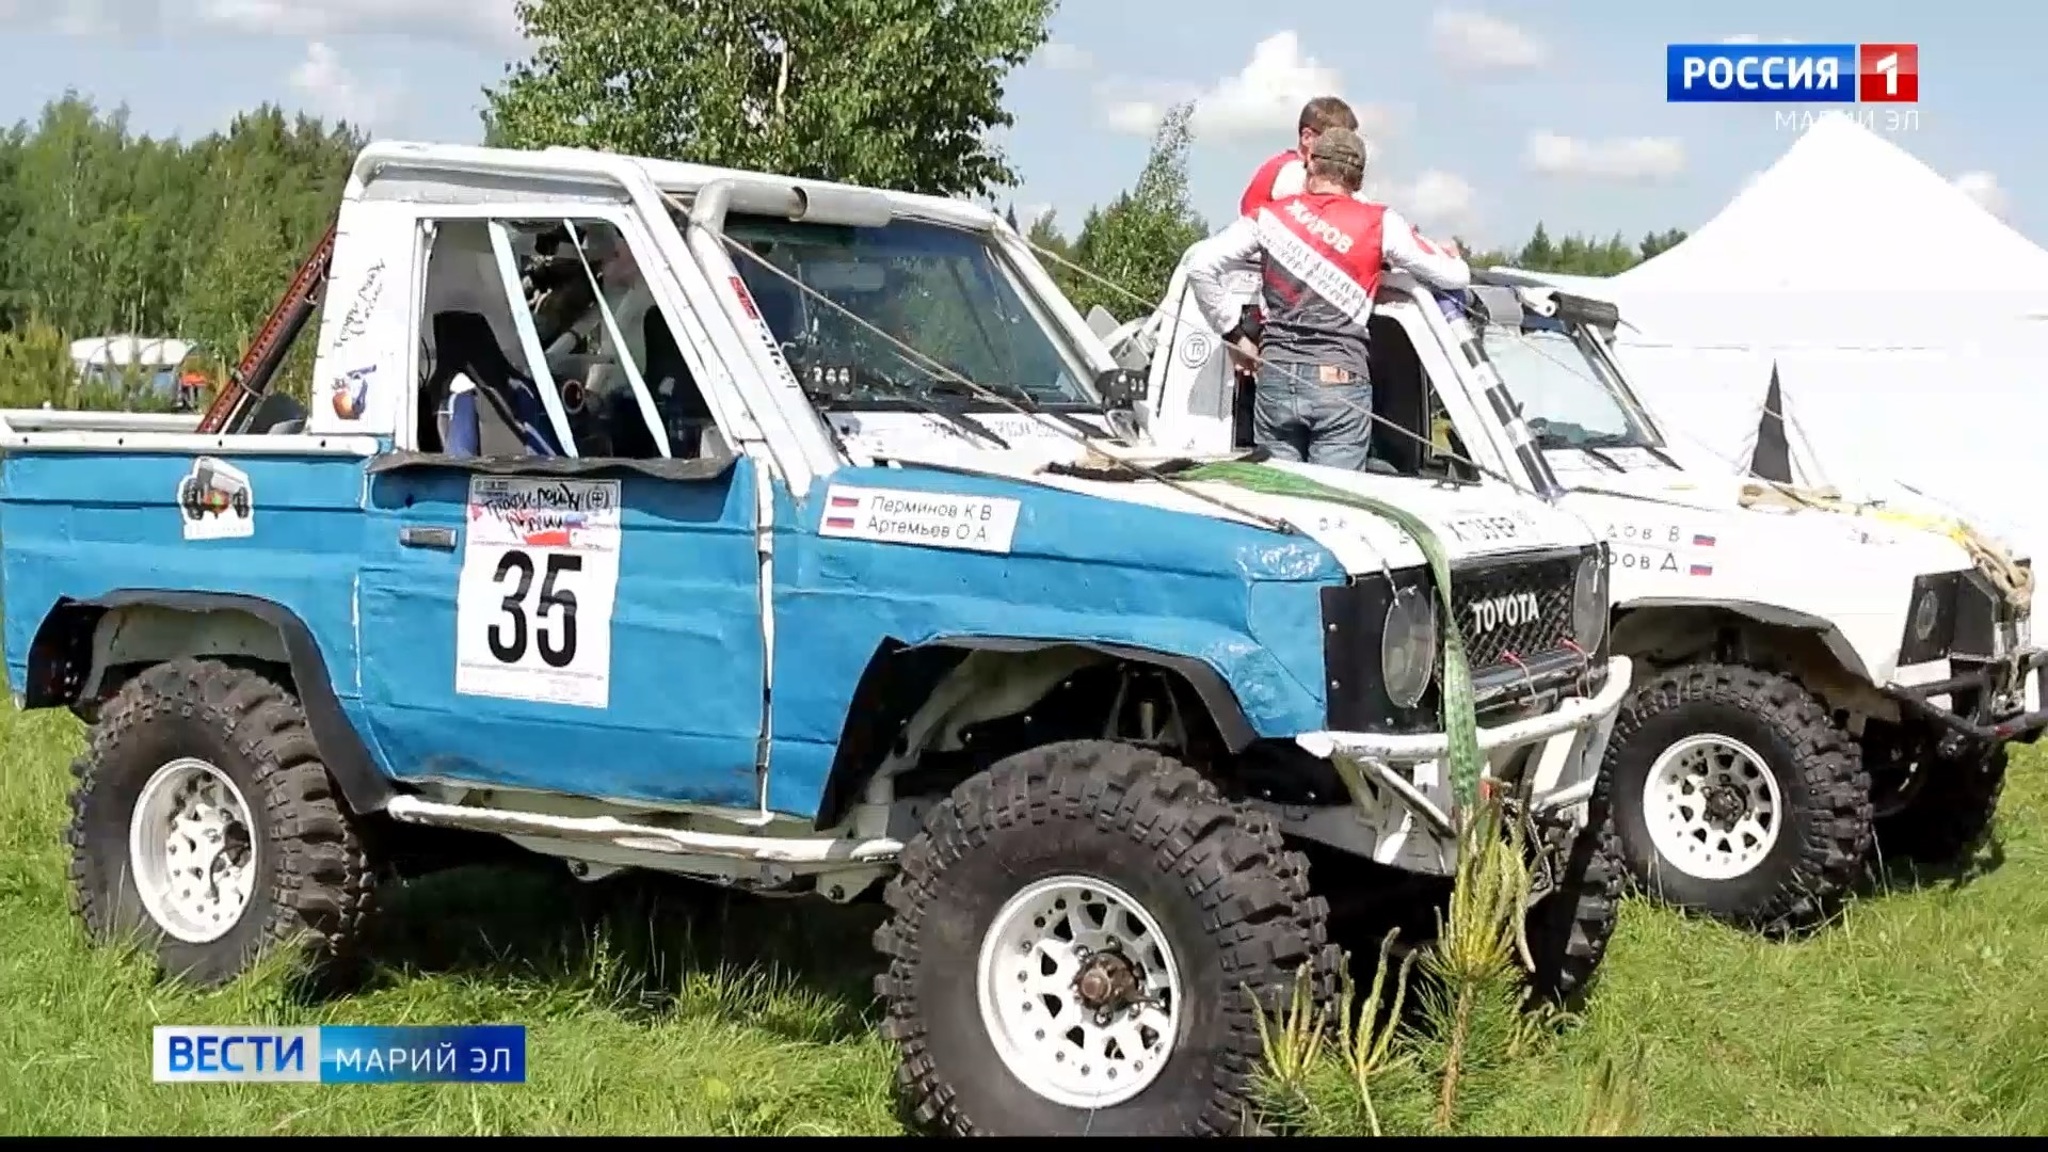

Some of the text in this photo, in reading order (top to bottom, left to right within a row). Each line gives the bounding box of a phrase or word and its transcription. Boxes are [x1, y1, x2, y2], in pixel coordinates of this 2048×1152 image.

[1284, 199, 1355, 254] ЖИРОВ
[870, 496, 992, 521] Перминов К В
[867, 516, 988, 543] Артемьев О А
[1660, 551, 1678, 572] Д
[487, 549, 583, 668] 35
[1471, 592, 1540, 634] TOYOTA
